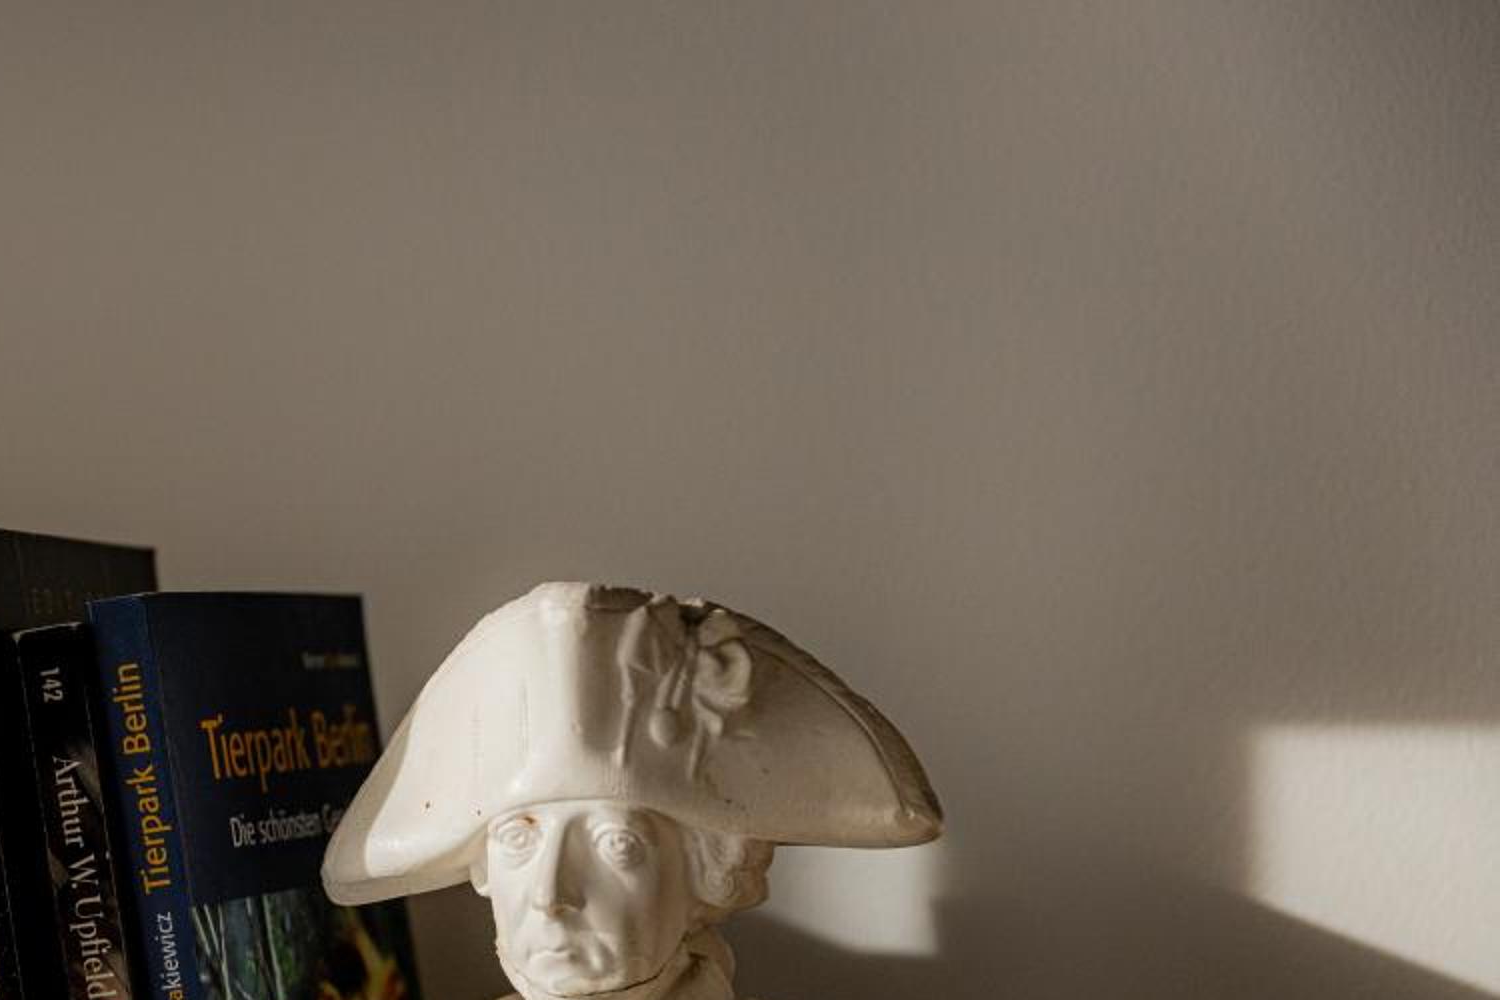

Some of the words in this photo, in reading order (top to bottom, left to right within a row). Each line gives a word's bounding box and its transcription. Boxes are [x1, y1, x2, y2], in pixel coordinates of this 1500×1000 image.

[114, 663, 153, 754] Berlin
[200, 707, 311, 793] Tierpark
[53, 755, 85, 847] Arthur
[126, 765, 172, 895] Tierpark
[66, 854, 98, 890] W.
[77, 893, 117, 999] Upfield
